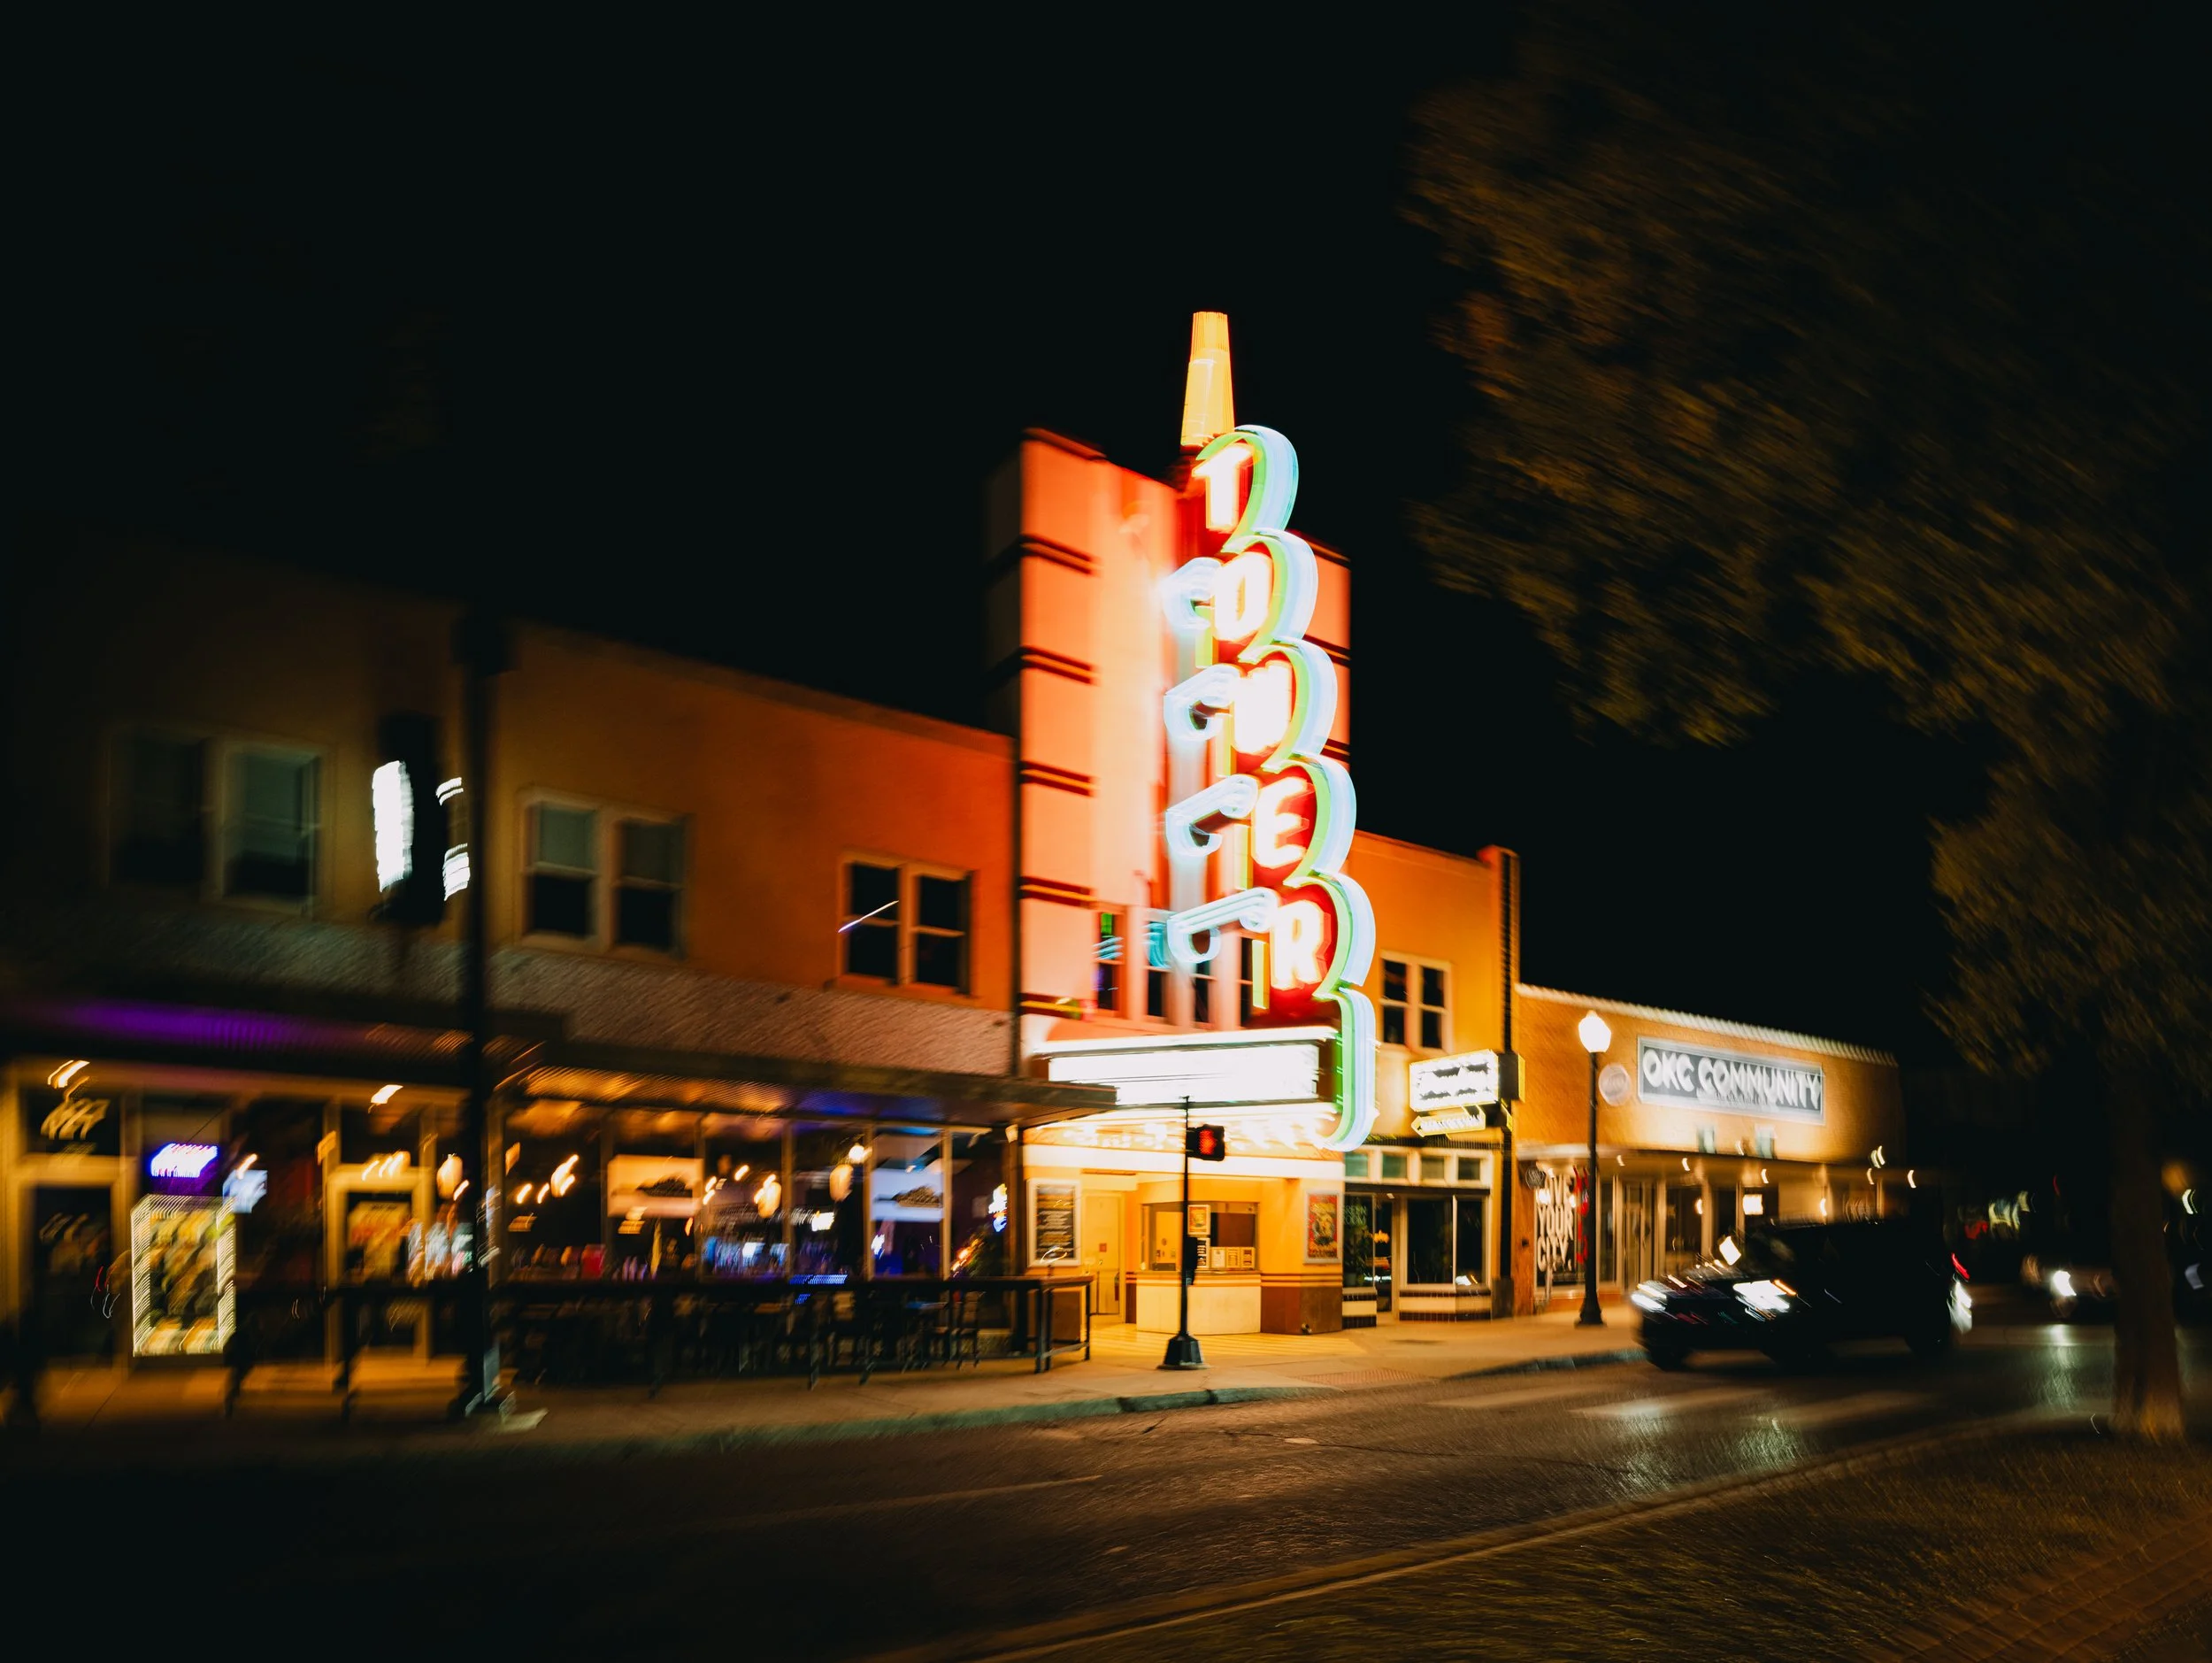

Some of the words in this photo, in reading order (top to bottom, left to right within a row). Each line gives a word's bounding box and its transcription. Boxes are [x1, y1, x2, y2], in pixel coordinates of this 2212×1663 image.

[1642, 1048, 1695, 1093] OKC
[1697, 1056, 1822, 1110] COMMUNITY
[1537, 1202, 1574, 1240] YOUR
